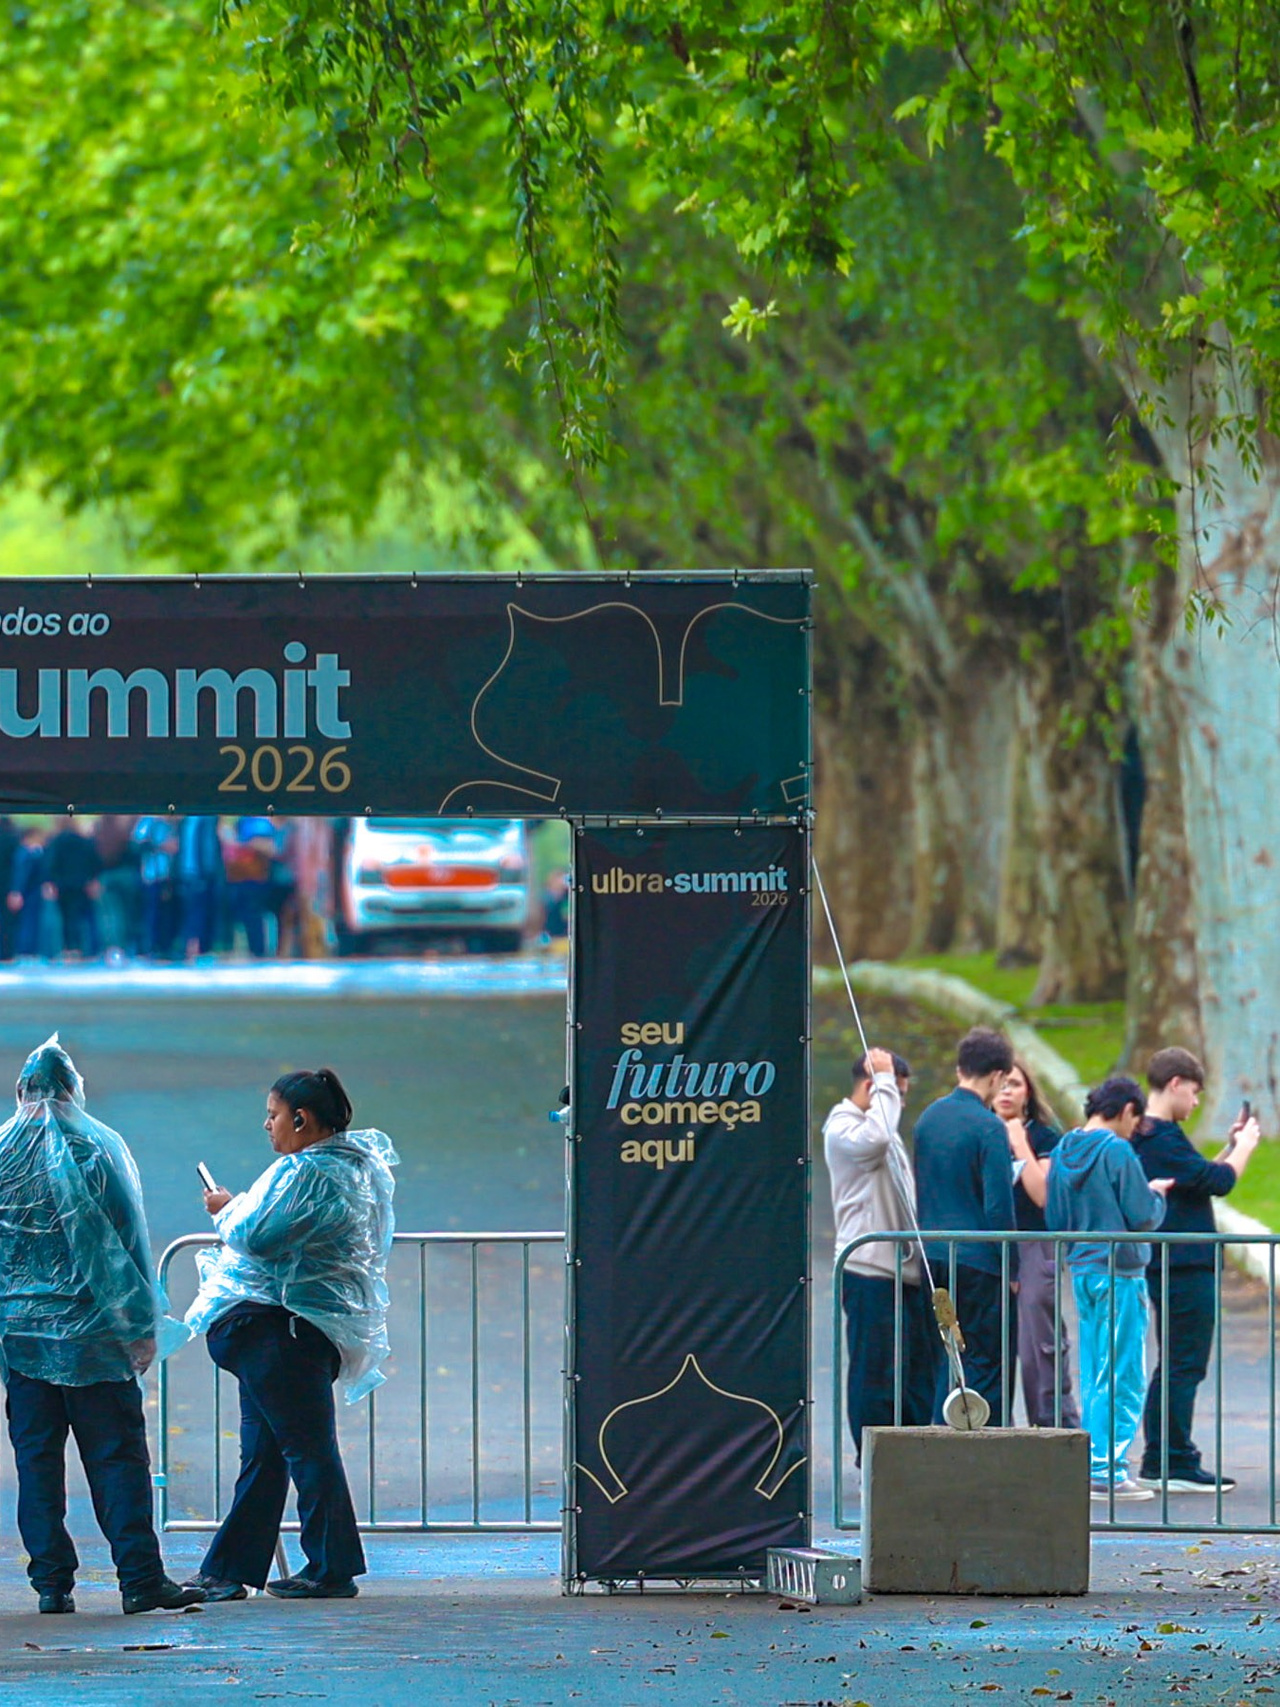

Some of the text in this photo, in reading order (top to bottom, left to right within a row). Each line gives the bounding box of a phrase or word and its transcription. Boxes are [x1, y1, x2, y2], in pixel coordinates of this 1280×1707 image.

[67, 613, 110, 636] ao
[217, 745, 352, 793] 2026
[751, 893, 788, 906] 2026
[621, 1021, 684, 1045] seu
[606, 1048, 776, 1110] futuro
[621, 1100, 761, 1131] começa
[621, 1131, 695, 1170] aqui
